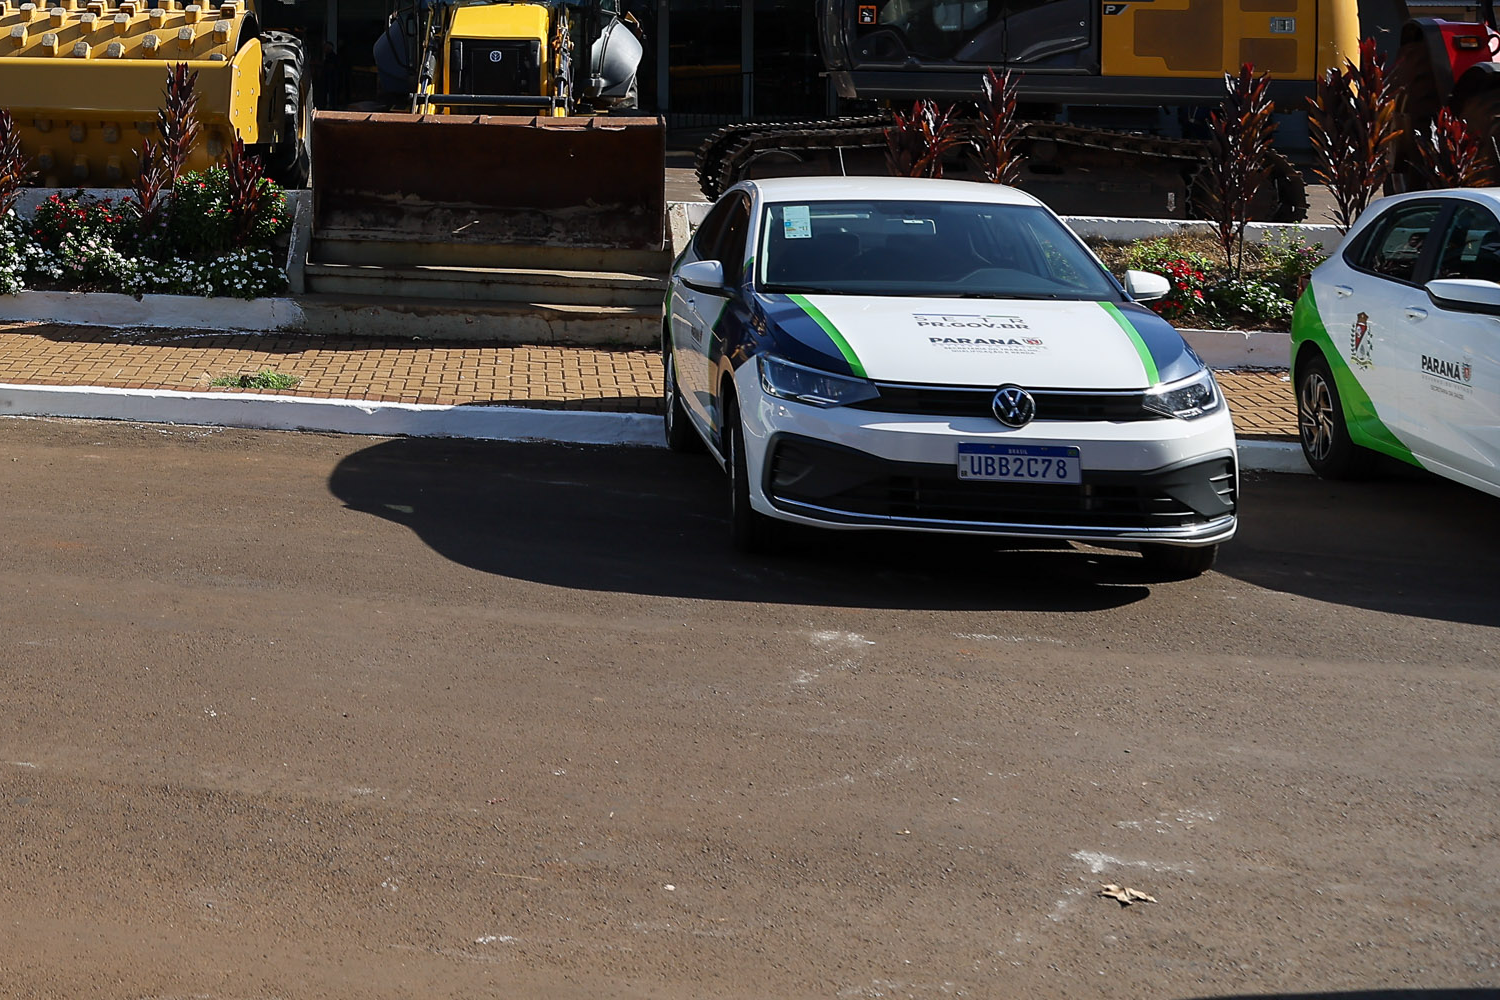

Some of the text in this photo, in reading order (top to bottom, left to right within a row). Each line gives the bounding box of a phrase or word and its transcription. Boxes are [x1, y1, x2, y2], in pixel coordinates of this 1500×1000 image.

[1105, 5, 1116, 14] P
[917, 321, 1031, 330] PR.GOV.BR
[1421, 354, 1461, 381] PARANÁ
[970, 455, 1068, 479] UBB2C78
